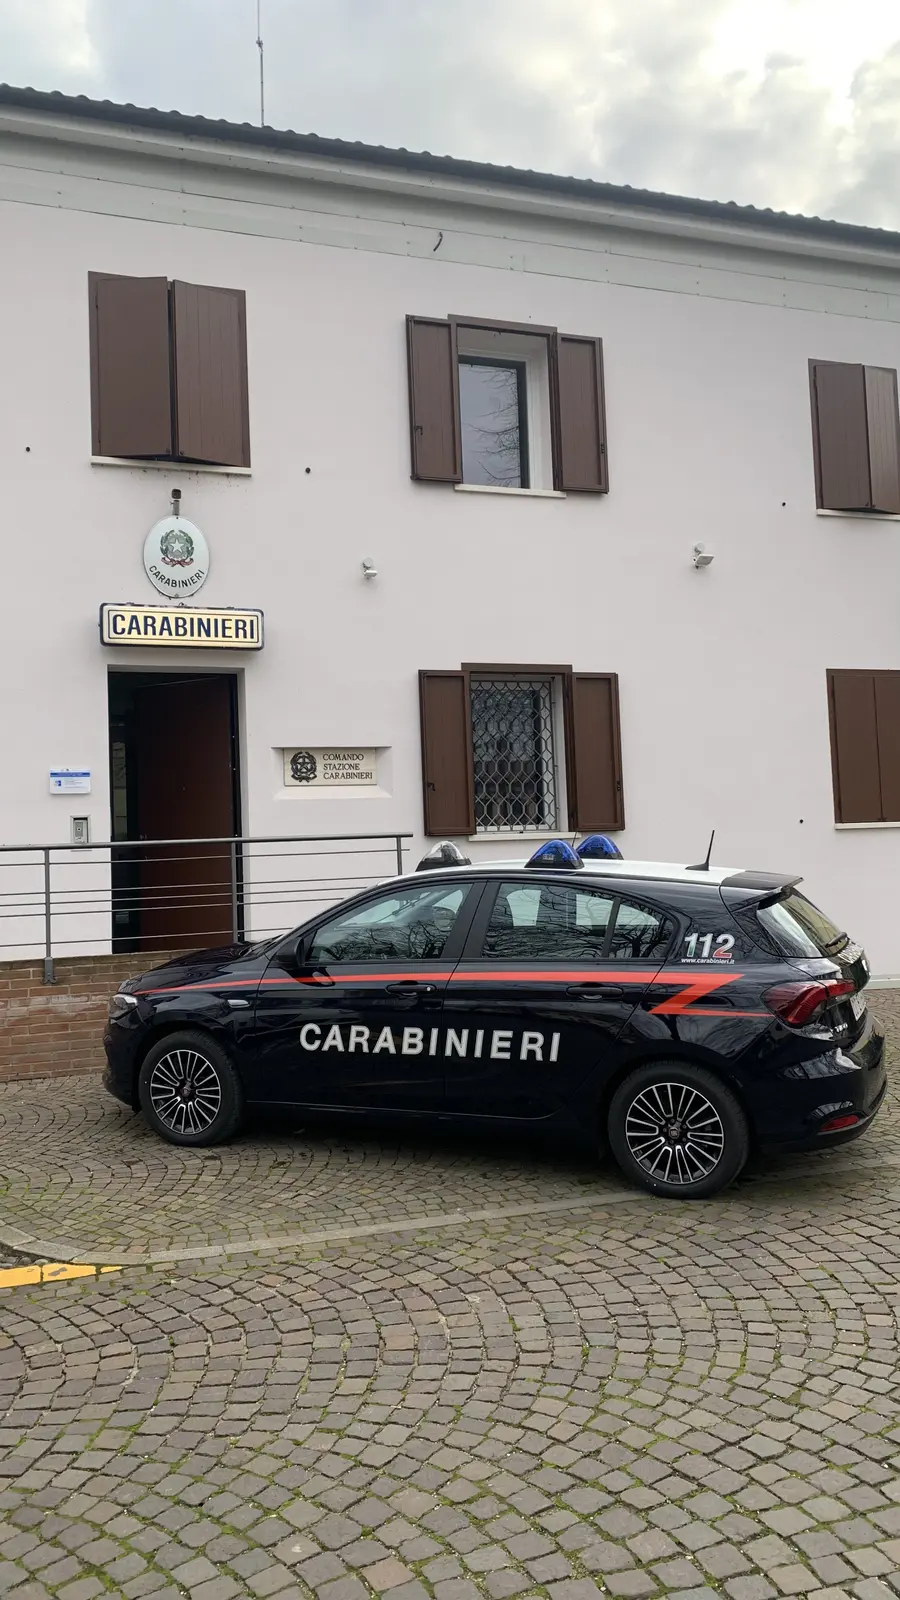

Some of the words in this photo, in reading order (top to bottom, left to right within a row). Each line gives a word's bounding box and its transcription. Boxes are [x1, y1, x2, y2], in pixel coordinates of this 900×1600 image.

[149, 565, 205, 589] CARABINIERI
[112, 614, 255, 640] CARABINIERI
[322, 753, 365, 761] COMANDO
[323, 763, 361, 771] STAZIONE
[323, 772, 373, 780] CARABINIERI
[684, 932, 736, 959] 112
[299, 1022, 562, 1062] CARABINIERI
